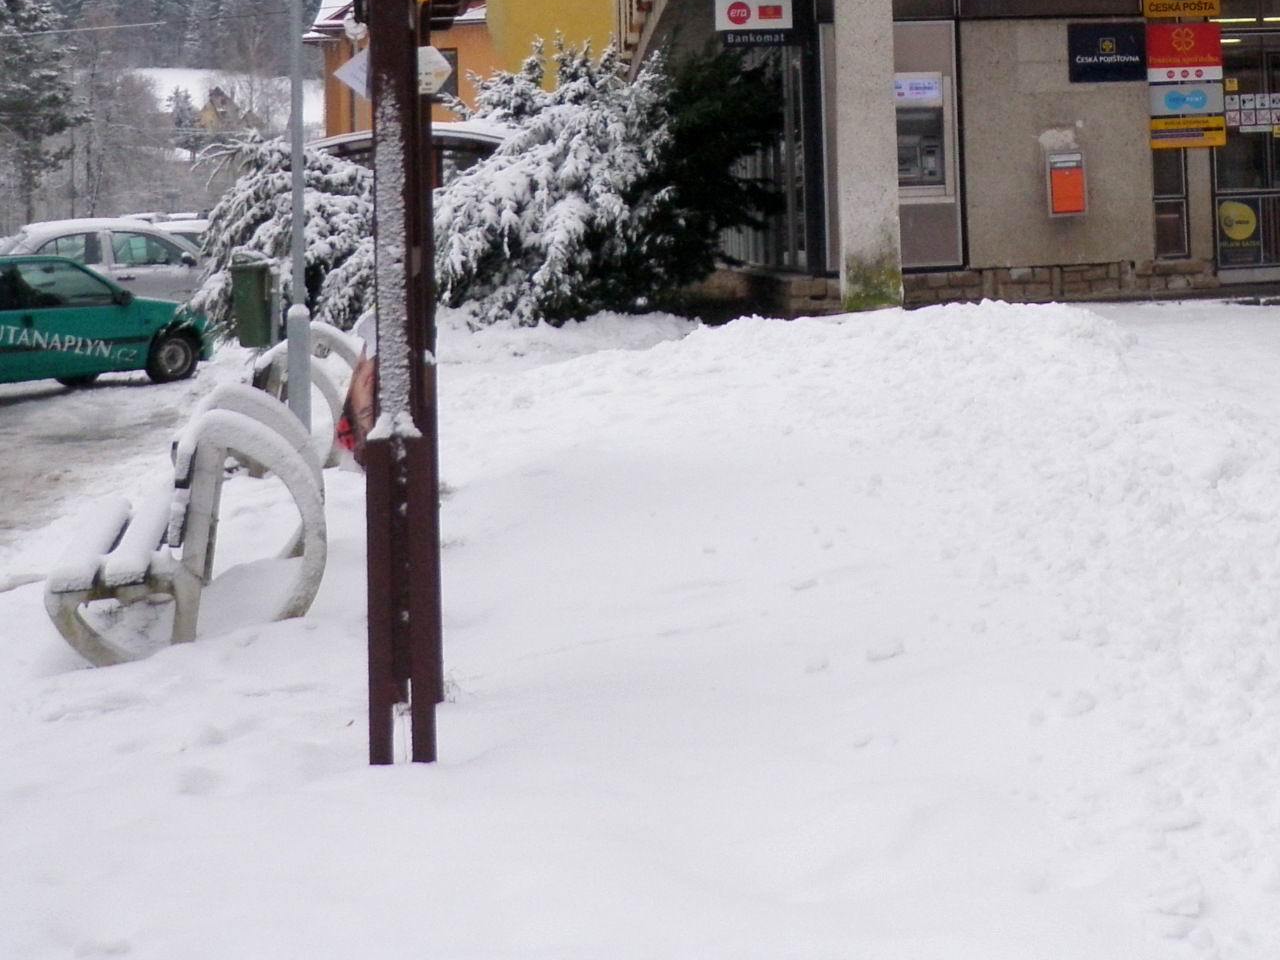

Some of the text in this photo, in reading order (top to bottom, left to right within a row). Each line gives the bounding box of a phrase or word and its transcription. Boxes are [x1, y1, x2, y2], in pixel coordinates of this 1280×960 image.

[1148, 0, 1216, 13] ČESKÁ POŠTA
[727, 33, 785, 44] Bankomat
[1075, 54, 1098, 64] ČESKÁ
